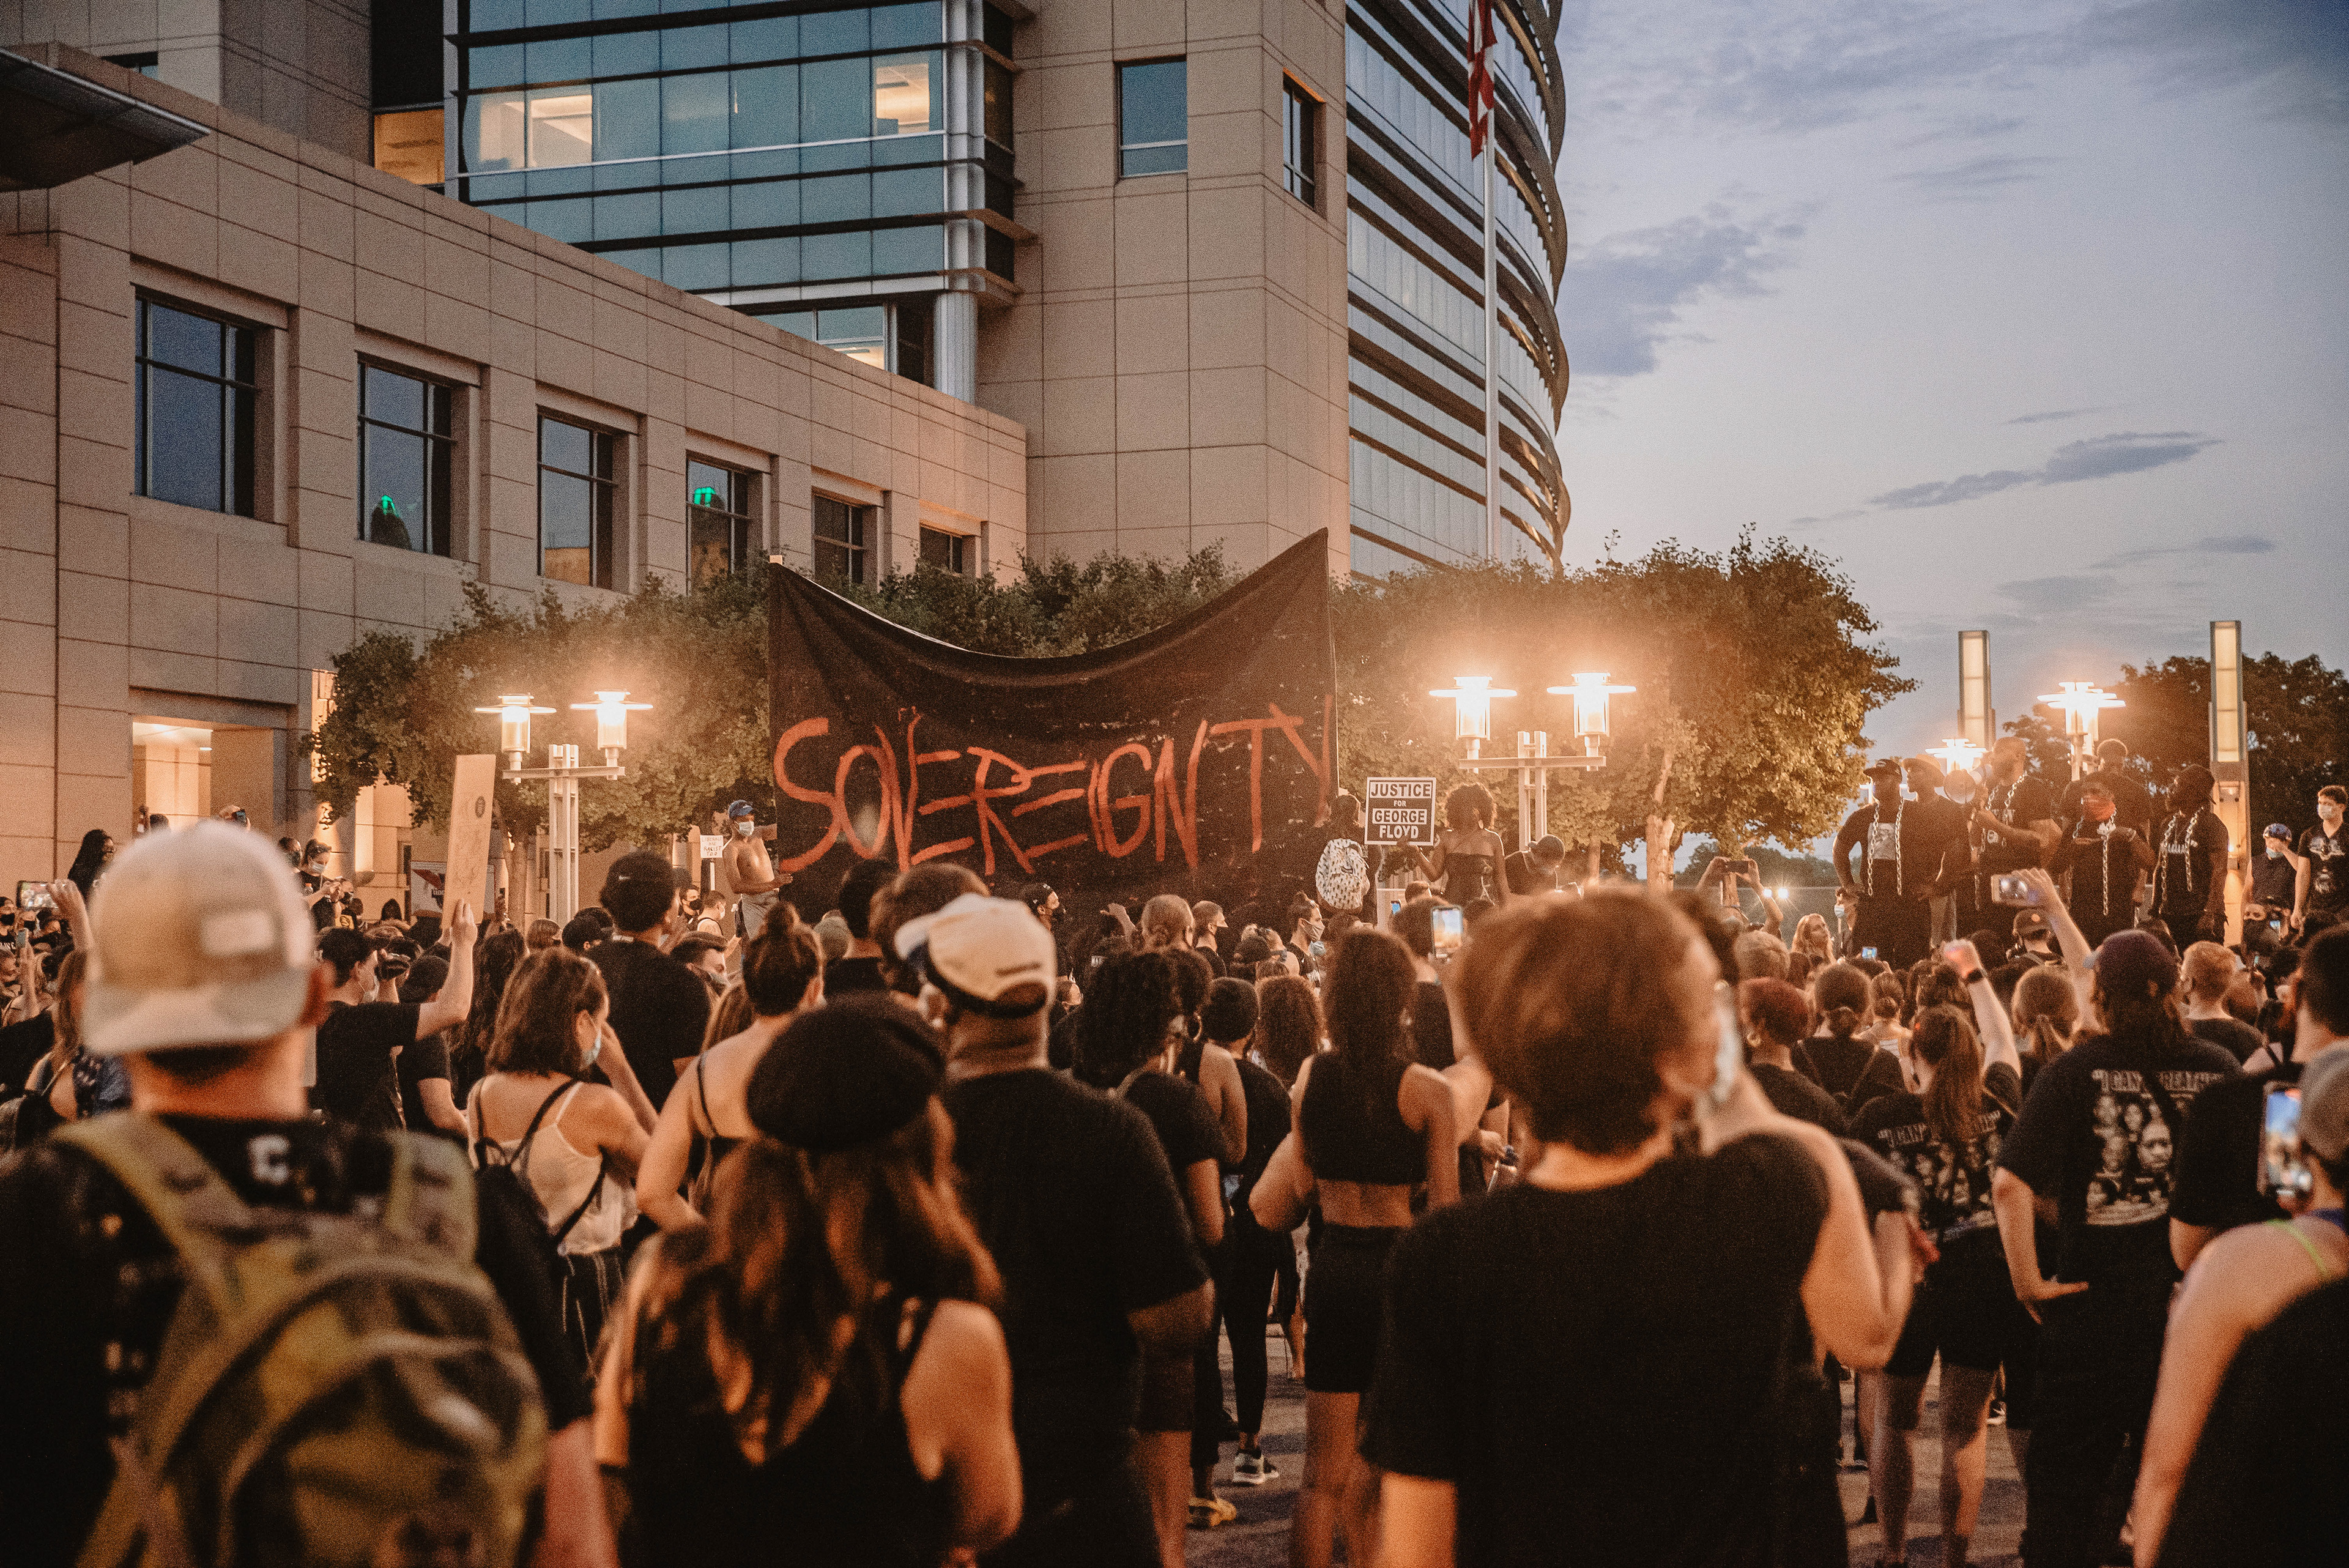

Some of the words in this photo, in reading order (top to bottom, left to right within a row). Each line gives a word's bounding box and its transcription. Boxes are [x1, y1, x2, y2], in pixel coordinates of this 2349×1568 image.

[774, 694, 1333, 874] SOVEREIGNTY
[1371, 783, 1431, 797] JUSTICE
[1374, 809, 1425, 823] GEORGE
[1379, 825, 1419, 839] FLOYD
